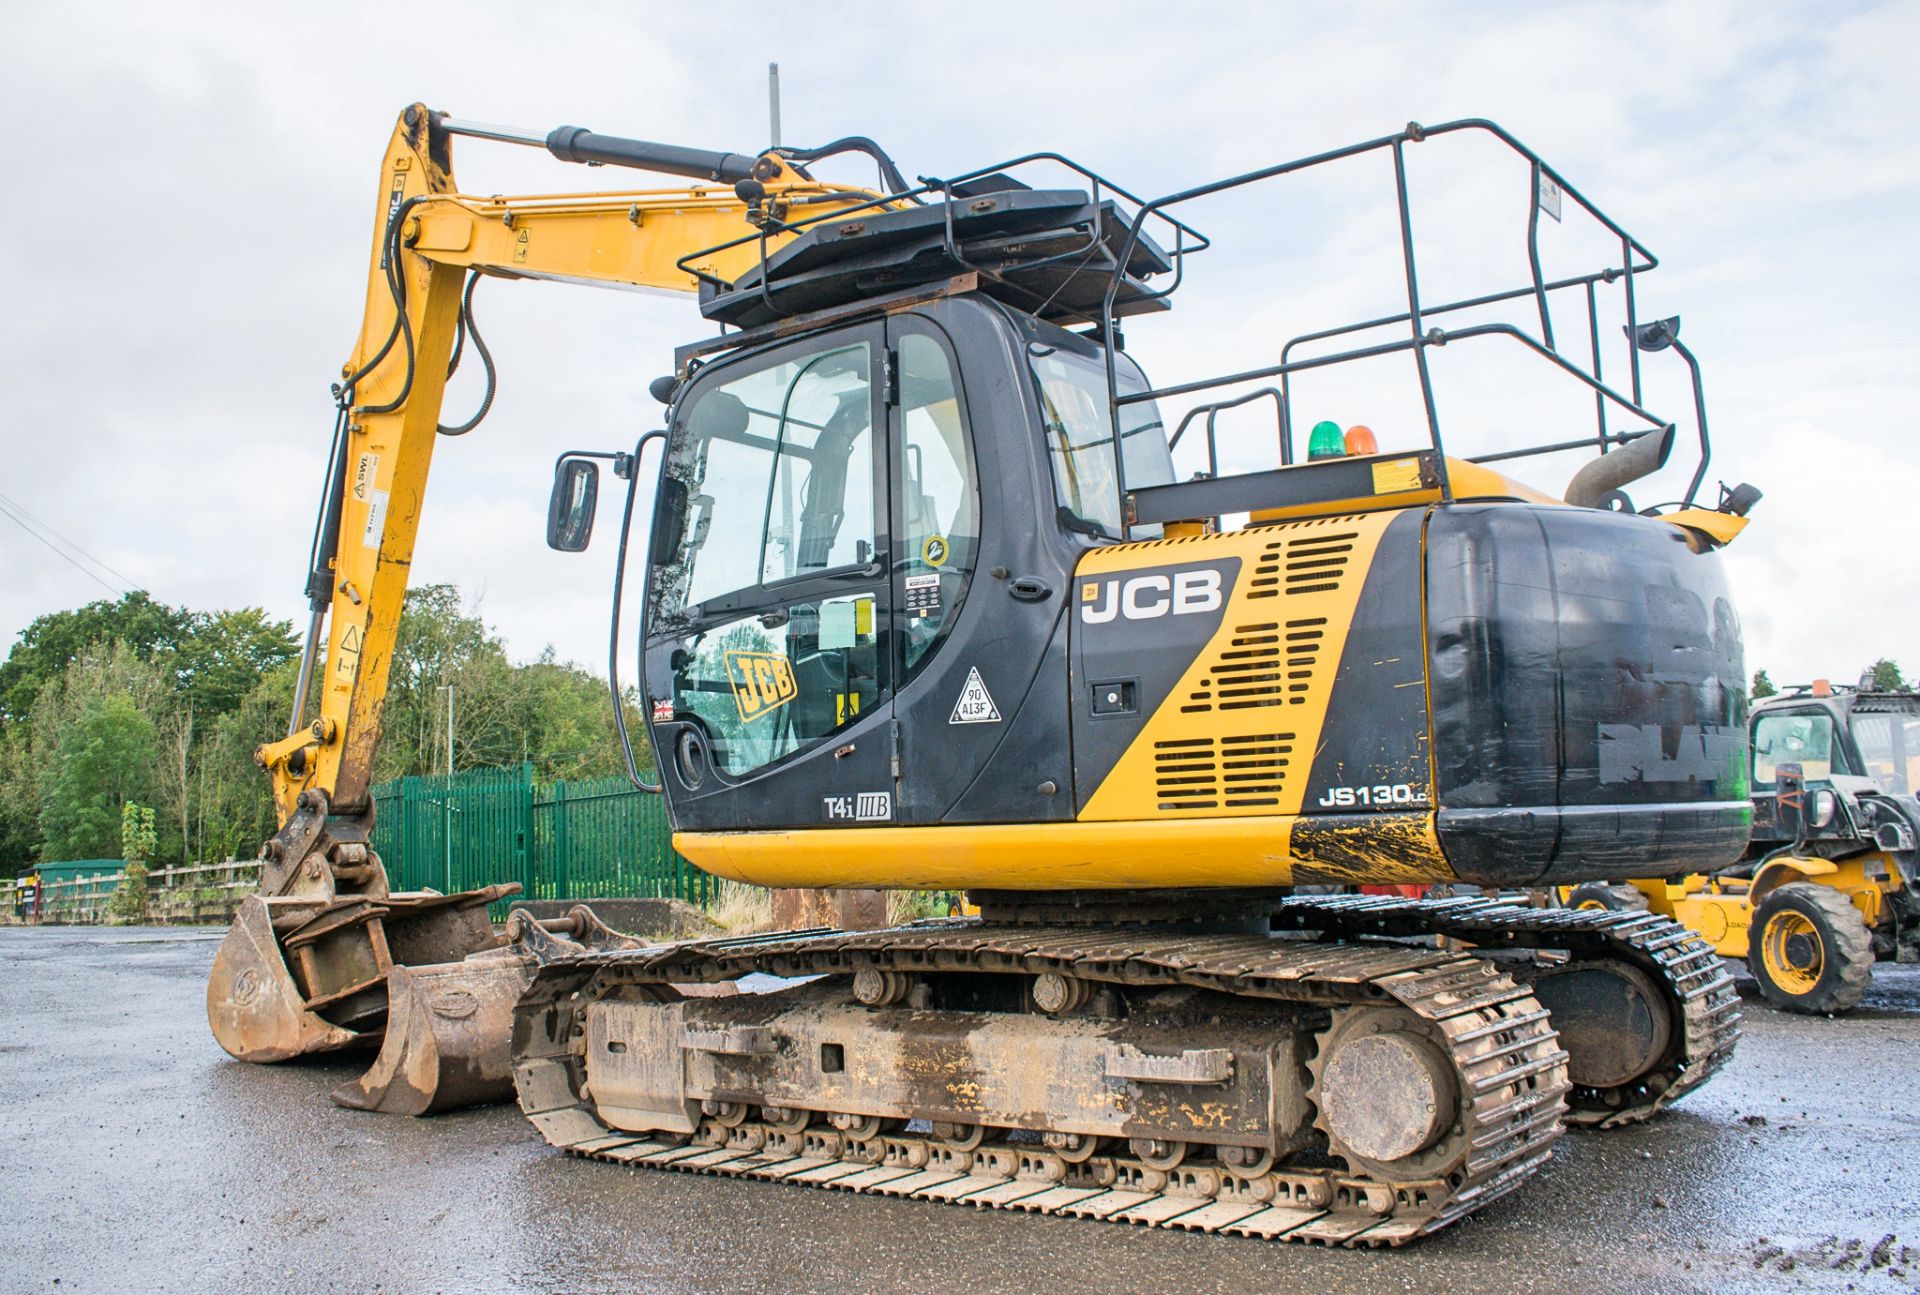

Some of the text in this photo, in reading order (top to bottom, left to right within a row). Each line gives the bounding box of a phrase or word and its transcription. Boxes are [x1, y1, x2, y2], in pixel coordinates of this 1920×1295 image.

[1081, 569, 1222, 624] JCB
[737, 657, 792, 713] JCB
[968, 688, 981, 701] 90
[823, 796, 854, 819] T4i
